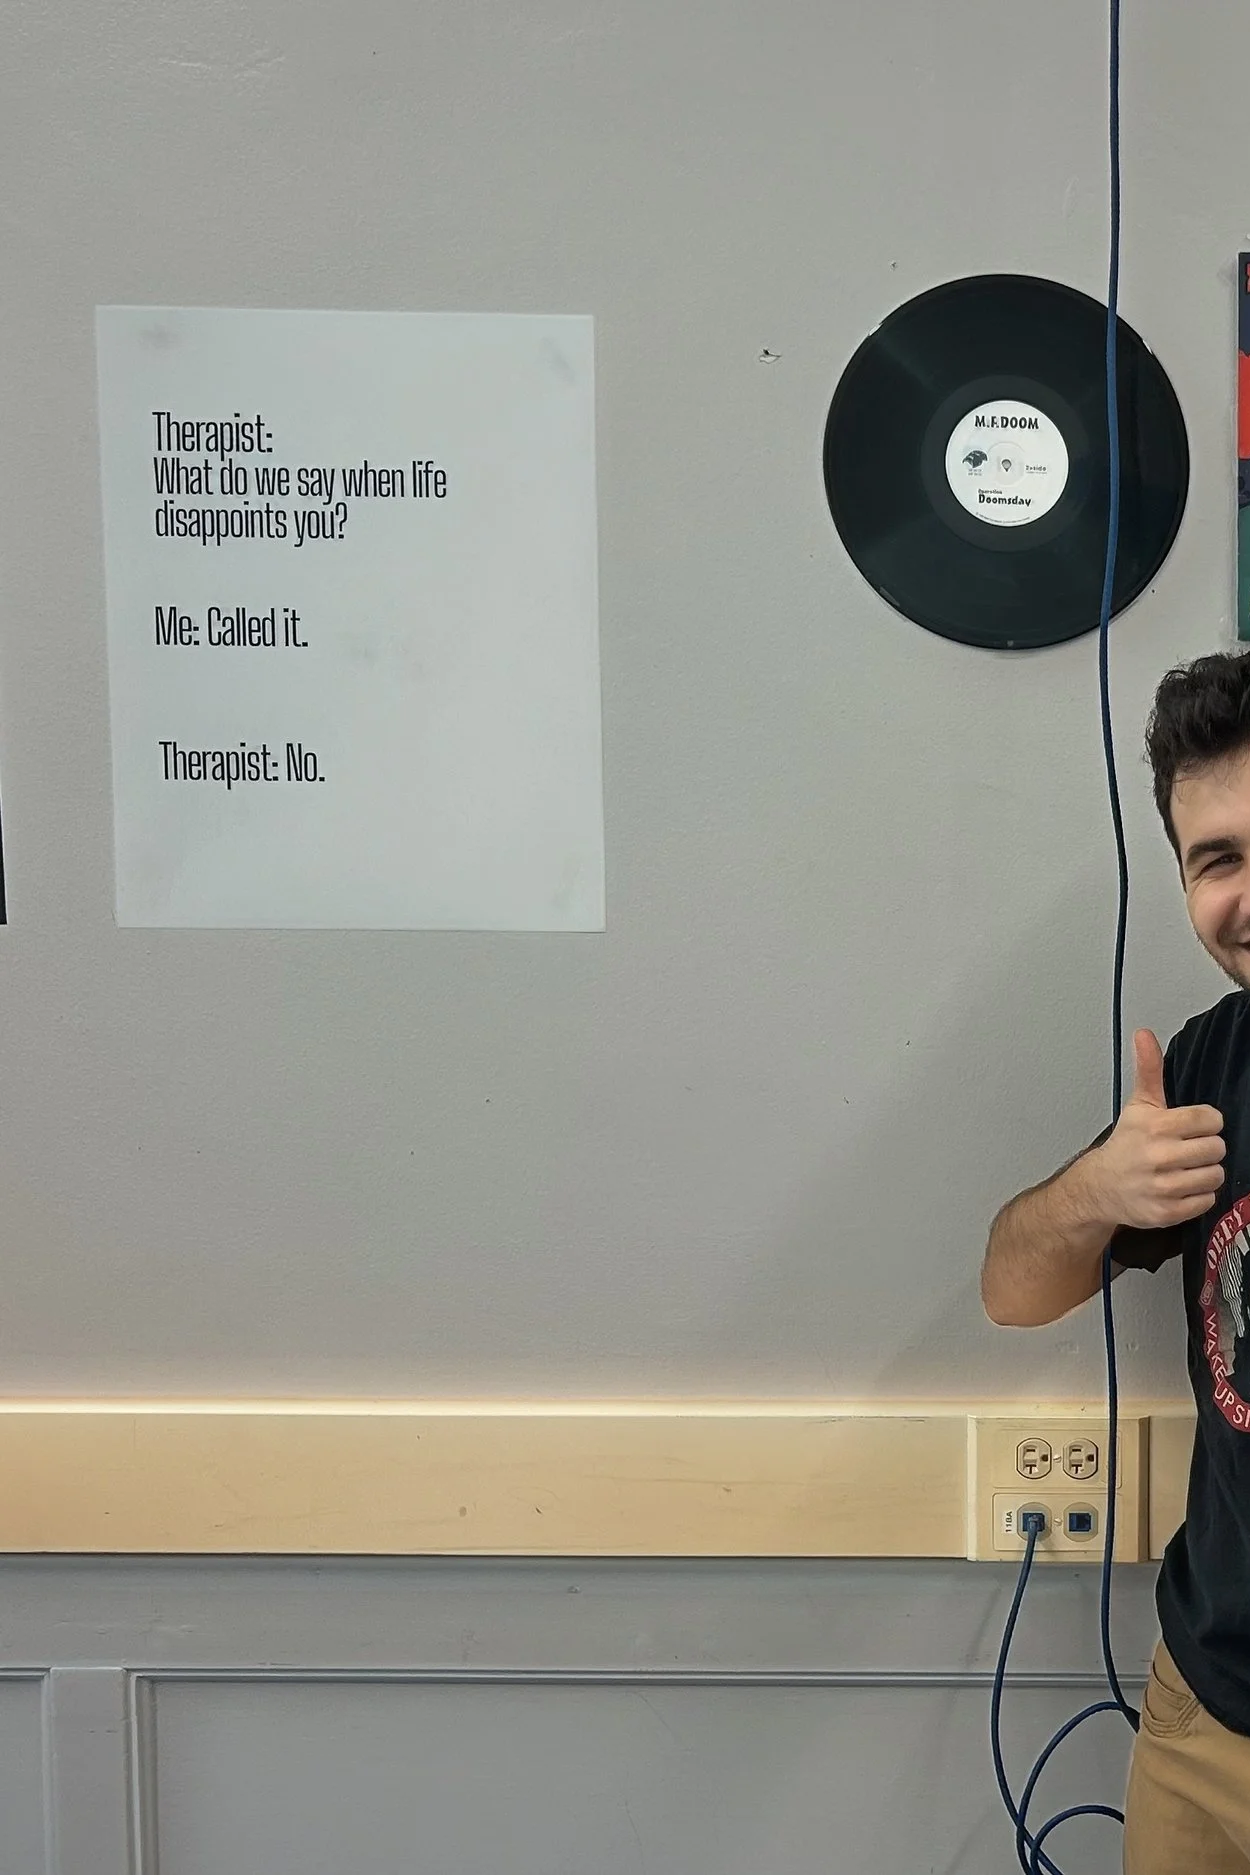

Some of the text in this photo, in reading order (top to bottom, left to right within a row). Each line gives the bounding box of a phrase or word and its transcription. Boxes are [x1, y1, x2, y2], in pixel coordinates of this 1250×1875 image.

[152, 411, 273, 461] Therapist:
[153, 457, 447, 505] What do we say when life
[978, 494, 1032, 507] Doomsday
[155, 500, 348, 547] disappoints you?
[155, 606, 309, 647] Me: Called it.
[158, 741, 326, 790] Therapist: No.
[1207, 1202, 1244, 1270] OBEY
[1206, 1312, 1227, 1382] WAKE
[1214, 1381, 1235, 1408] UP
